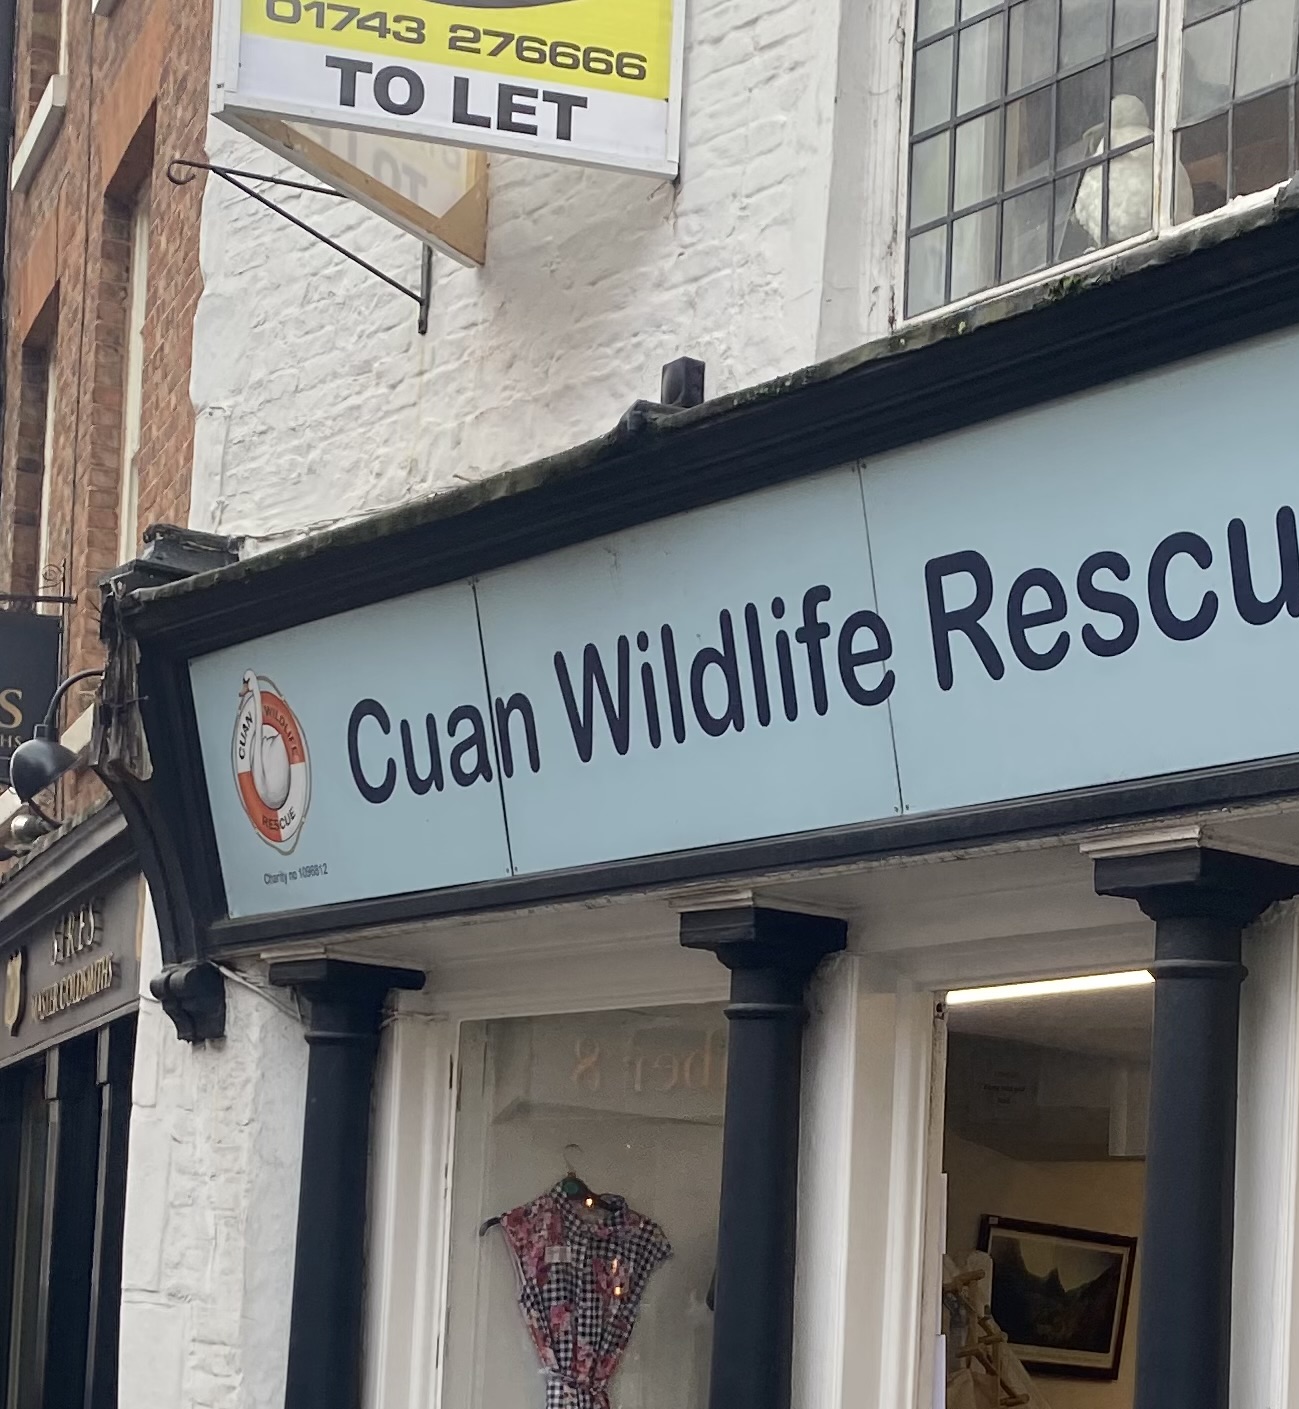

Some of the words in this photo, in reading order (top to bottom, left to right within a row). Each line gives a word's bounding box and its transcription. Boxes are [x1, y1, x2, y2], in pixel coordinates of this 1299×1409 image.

[266, 0, 426, 44] 01743
[449, 24, 647, 81] 276666
[326, 55, 425, 115] TO
[452, 76, 588, 141] LET
[348, 693, 540, 804] Cuan
[554, 584, 896, 762] Wildlife
[239, 711, 253, 760] CUAN
[264, 705, 298, 758] WILDLIFE
[262, 806, 296, 830] RESCUE
[264, 871, 288, 885] Charity
